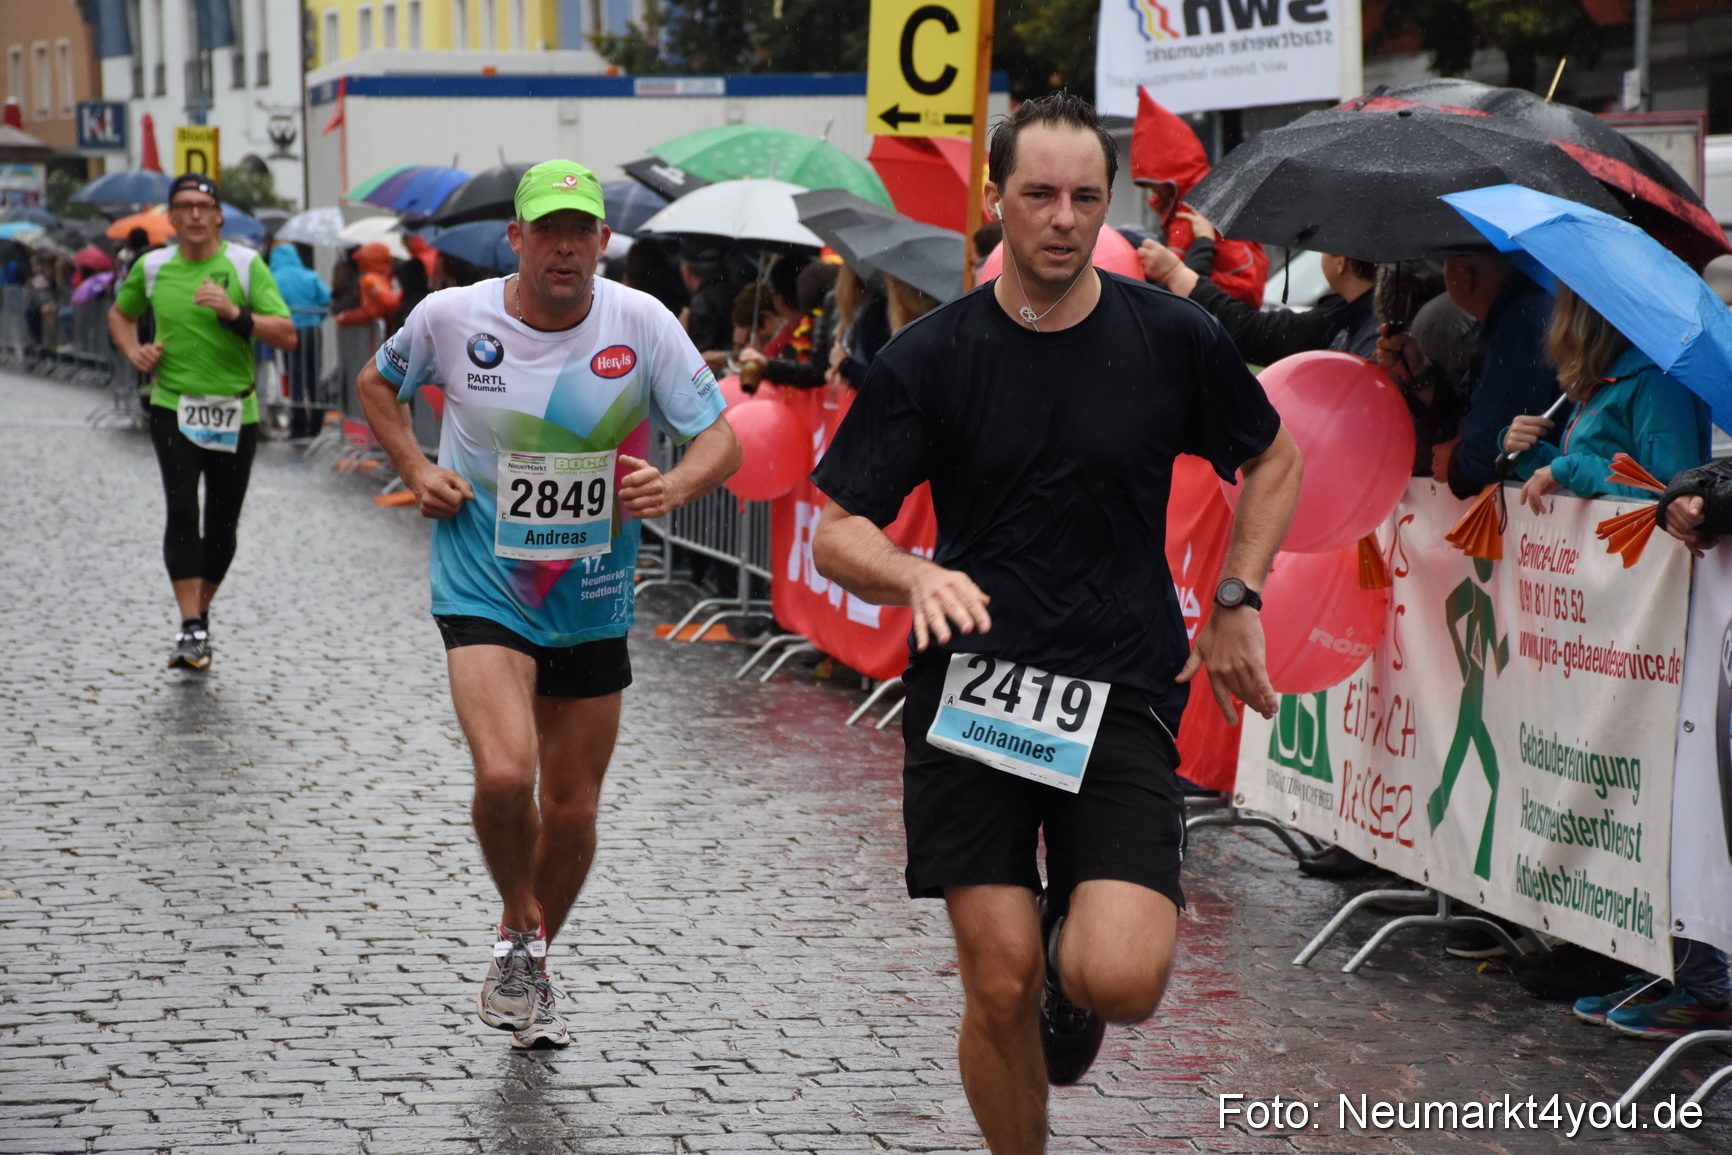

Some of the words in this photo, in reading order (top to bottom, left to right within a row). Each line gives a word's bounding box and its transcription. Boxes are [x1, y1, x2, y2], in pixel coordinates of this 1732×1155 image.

[899, 4, 960, 96] C
[186, 148, 208, 176] D
[597, 353, 632, 370] Hervis
[467, 373, 506, 386] PARTL
[467, 383, 507, 393] Neumarkt
[185, 405, 237, 428] 2097
[508, 462, 547, 472] NeuerMarkt
[554, 456, 608, 470] BOCK
[509, 477, 606, 519] 2849
[524, 530, 588, 545] Andreas
[581, 554, 605, 575] 17.
[1518, 533, 1580, 576] Service-Line:
[581, 582, 623, 601] Stadtlauf
[958, 654, 1092, 733] 2419
[961, 720, 1057, 763] Johannes
[1519, 721, 1641, 806] Gebäudereinigung
[1520, 787, 1642, 863] Hausmeisterdienst
